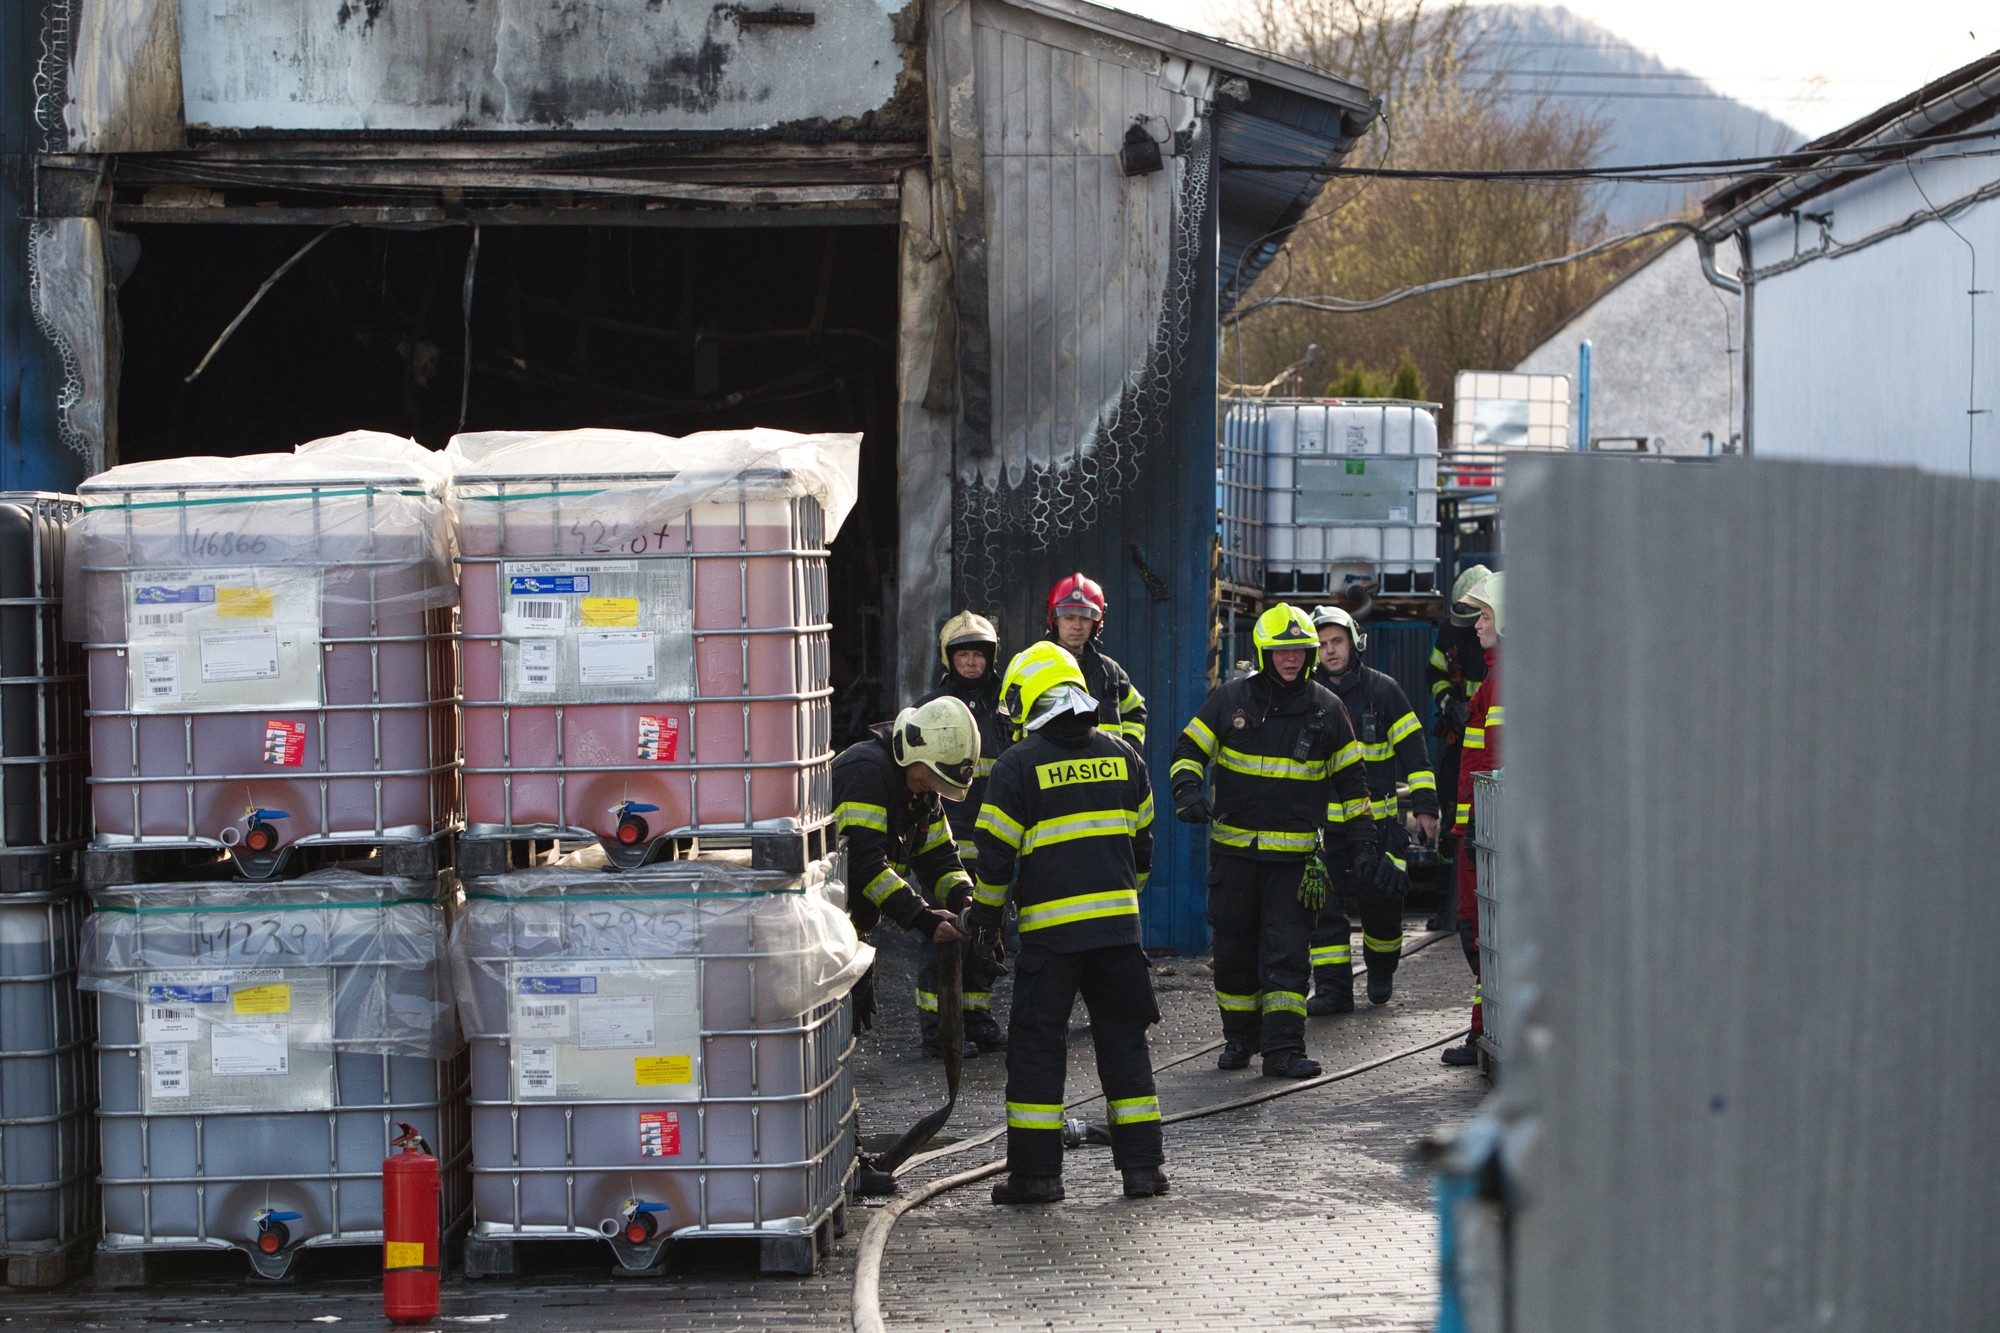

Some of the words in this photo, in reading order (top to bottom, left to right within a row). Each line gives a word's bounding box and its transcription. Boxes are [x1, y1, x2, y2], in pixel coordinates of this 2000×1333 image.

[192, 527, 266, 557] 46866
[1048, 760, 1119, 784] HASIČI
[200, 919, 307, 956] 41239
